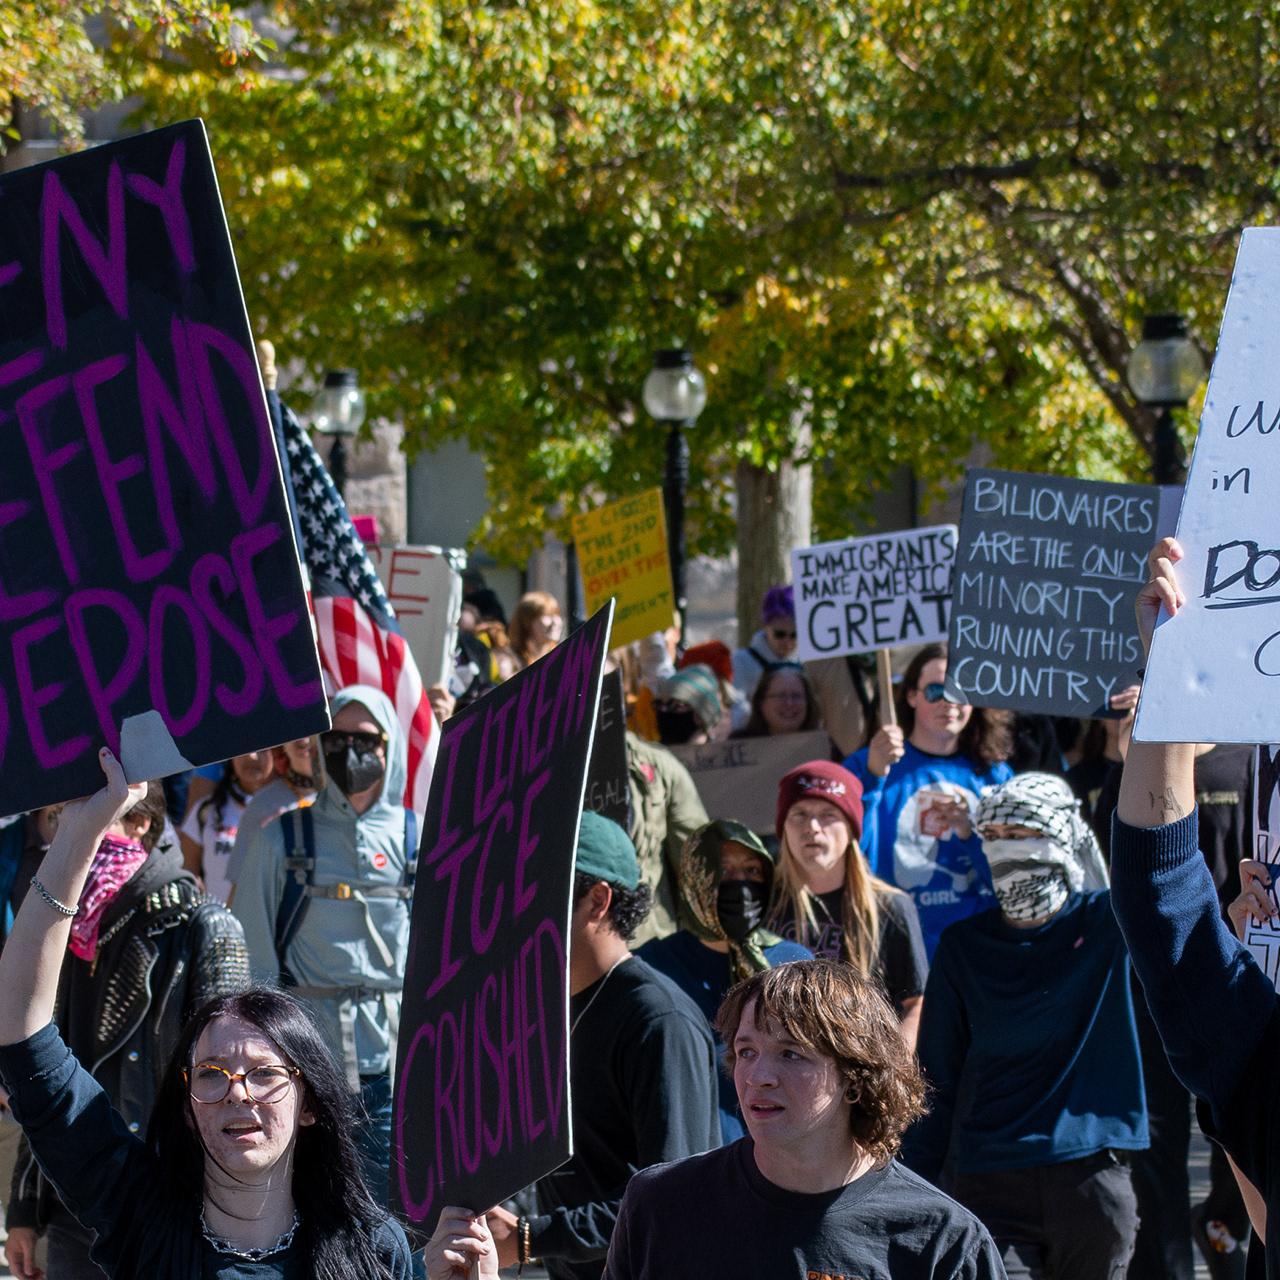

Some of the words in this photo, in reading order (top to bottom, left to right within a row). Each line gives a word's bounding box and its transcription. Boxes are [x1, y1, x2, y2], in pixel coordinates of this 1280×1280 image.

[1210, 467, 1250, 494] in
[799, 532, 955, 578] IMMIGRANTS
[969, 531, 1029, 565] ARE
[1030, 537, 1075, 569] THE
[1081, 544, 1149, 581] ONLY
[802, 574, 852, 600] MAKE
[960, 572, 1124, 625] MINORITY
[808, 594, 953, 652] GREAT
[956, 615, 1075, 660] RUINING
[1080, 627, 1141, 662] THIS
[954, 656, 1117, 711] COUNTRY
[426, 709, 478, 865] I
[473, 648, 560, 828] LIKE
[547, 621, 602, 748] MY
[427, 766, 552, 999] ICE
[920, 890, 961, 907] GIRL
[396, 917, 568, 1225] CRUSHED
